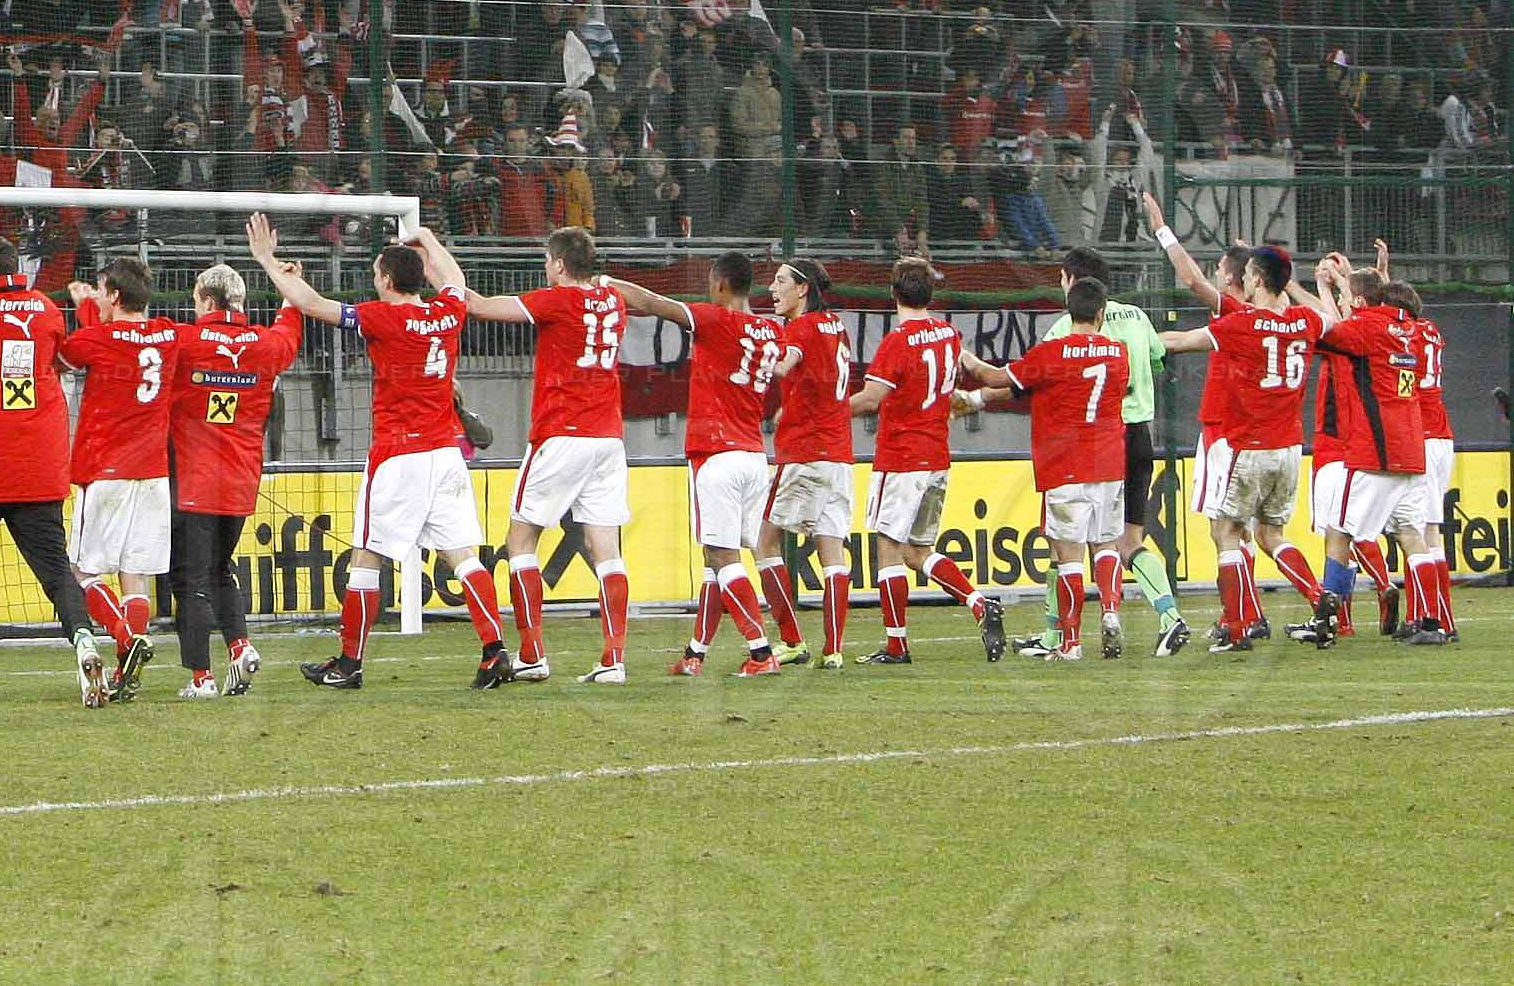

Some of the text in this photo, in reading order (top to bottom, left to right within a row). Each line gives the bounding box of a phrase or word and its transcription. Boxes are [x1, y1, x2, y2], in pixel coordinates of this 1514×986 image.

[423, 336, 448, 379] 4
[575, 311, 620, 370] 15
[1062, 343, 1122, 358] korkmaz
[1260, 336, 1308, 389] 16
[136, 346, 163, 404] 3
[1082, 362, 1107, 423] 7
